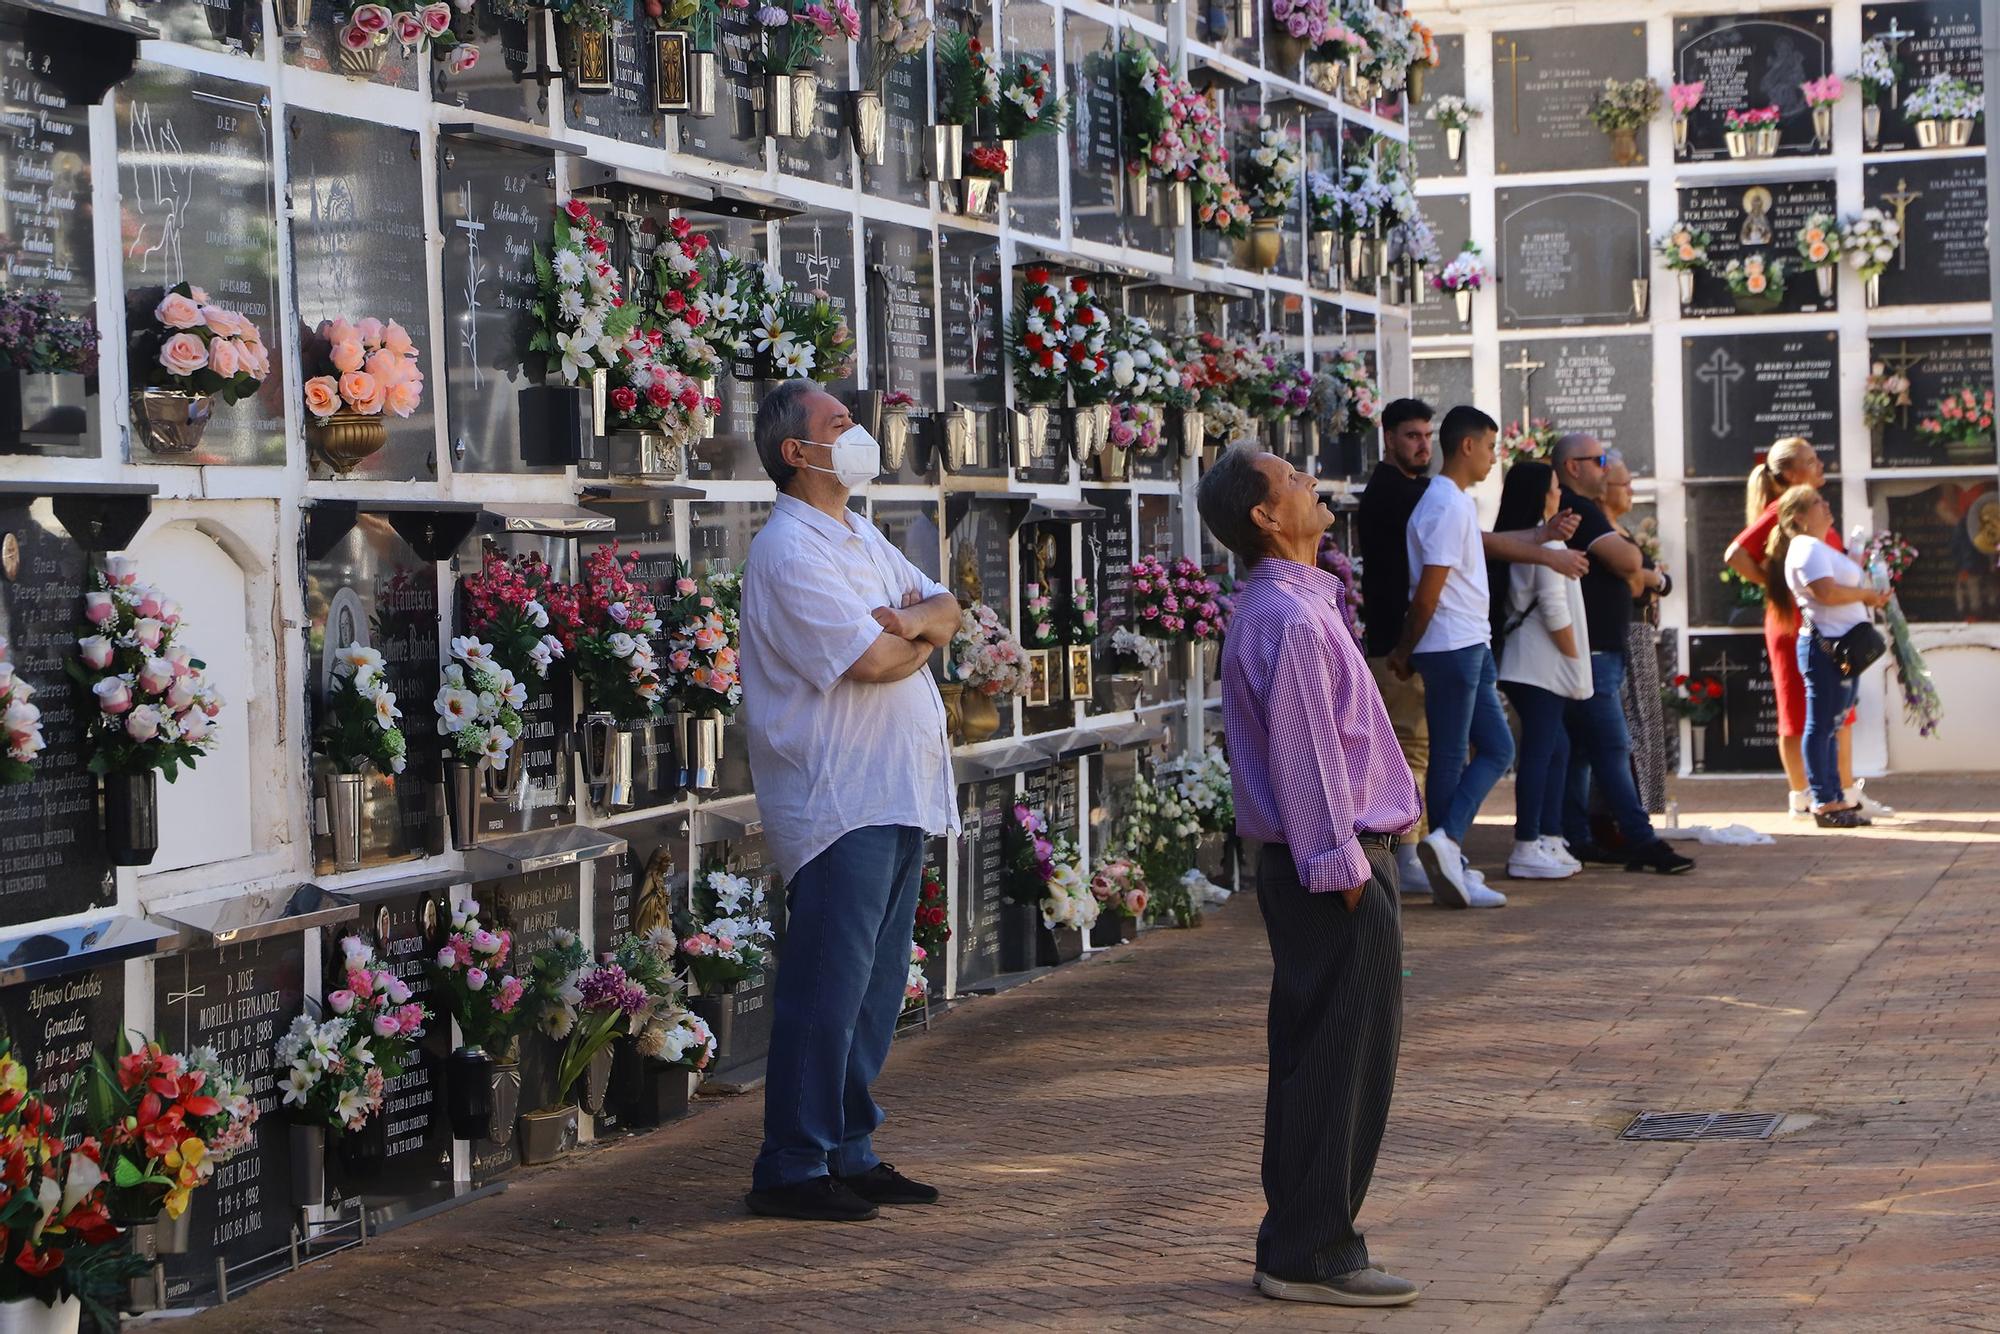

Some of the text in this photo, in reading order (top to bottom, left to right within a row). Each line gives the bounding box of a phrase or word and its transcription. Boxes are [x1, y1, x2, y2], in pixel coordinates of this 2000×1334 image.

[28, 973, 102, 1018] Alfonso Cordobés
[236, 968, 254, 994] JOSE
[44, 1008, 86, 1046] González
[199, 990, 280, 1031] MORILLA FERNANDEZ
[217, 1156, 261, 1190] RICH BELLO
[220, 1221, 233, 1243] LOS
